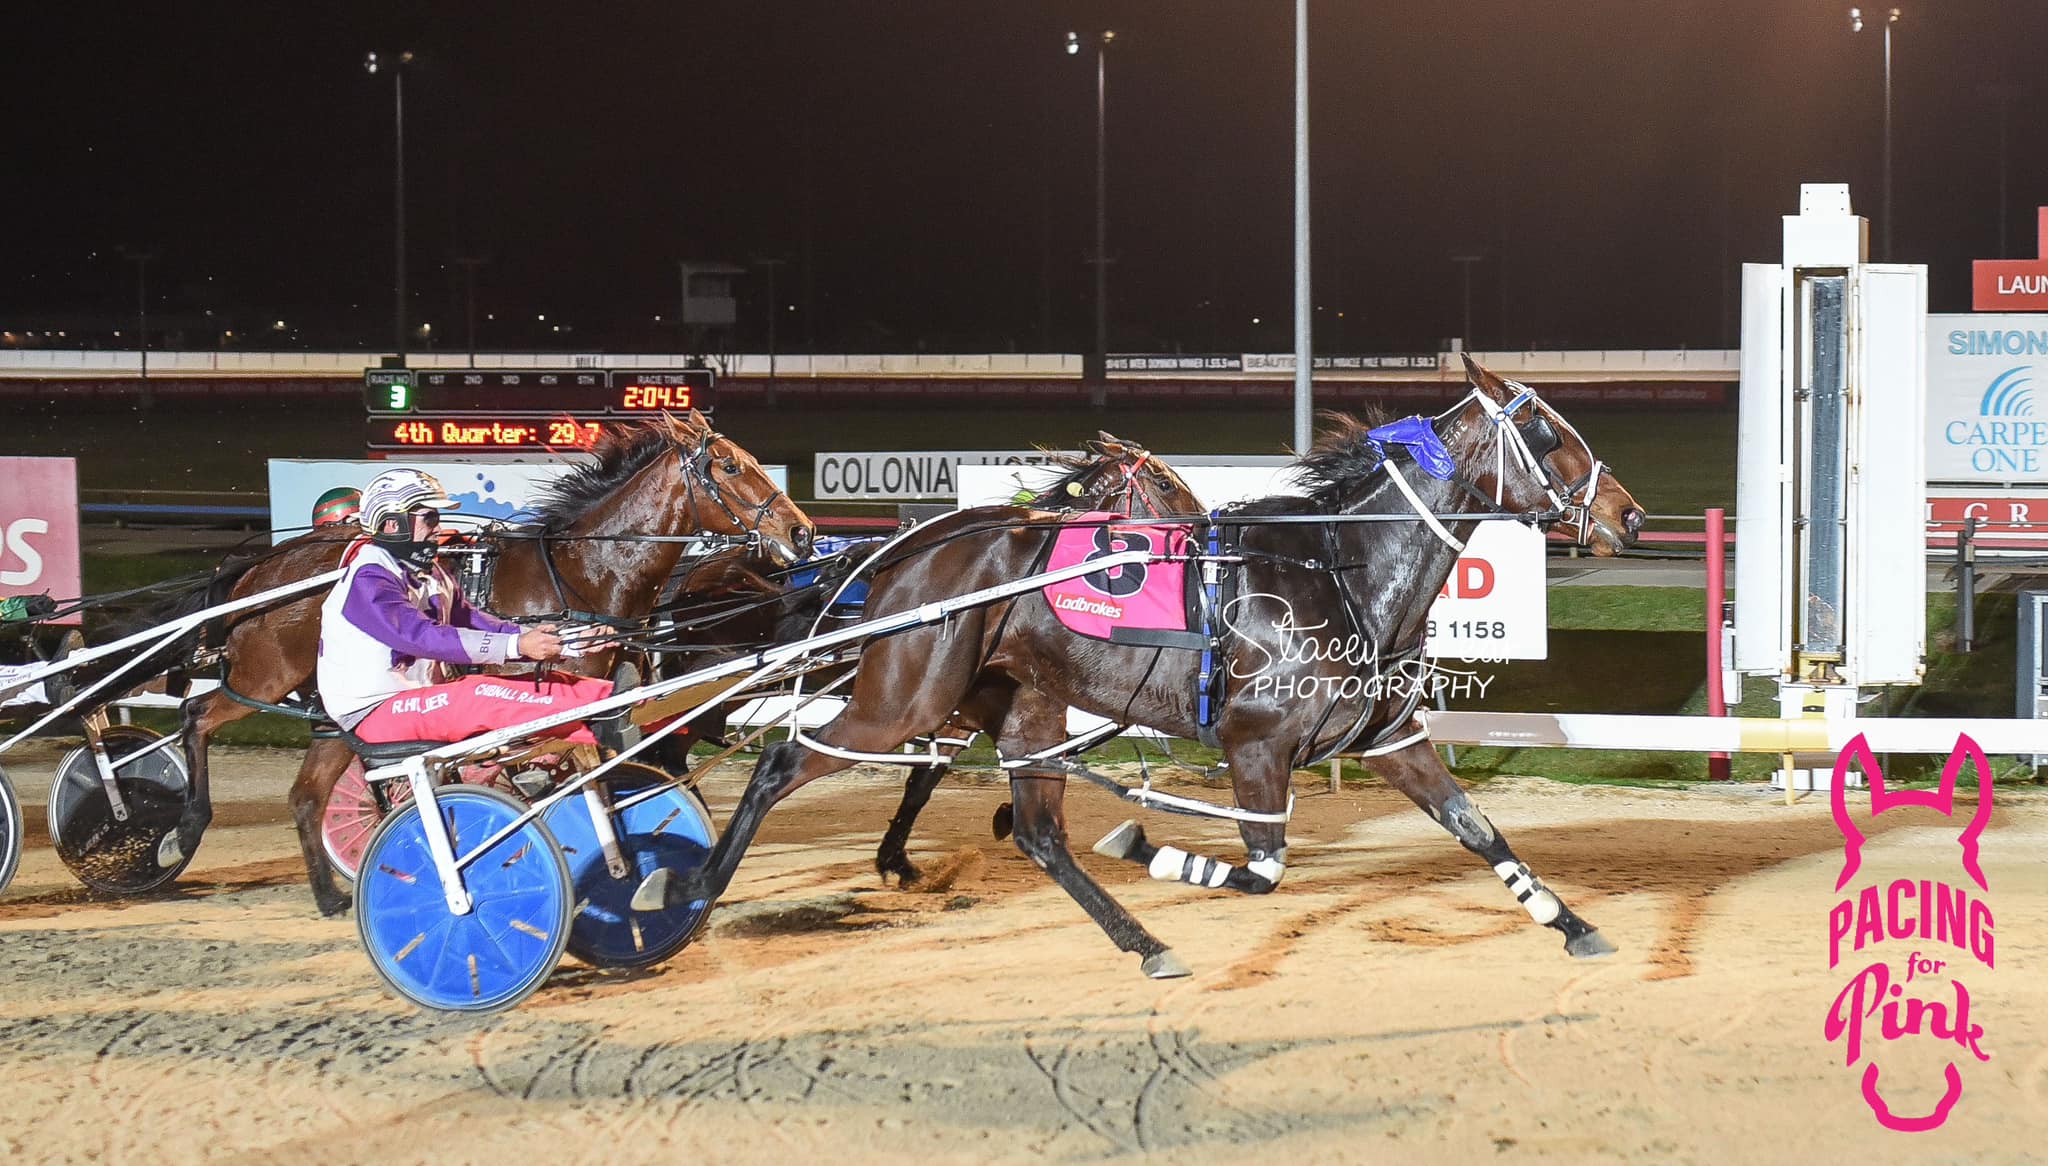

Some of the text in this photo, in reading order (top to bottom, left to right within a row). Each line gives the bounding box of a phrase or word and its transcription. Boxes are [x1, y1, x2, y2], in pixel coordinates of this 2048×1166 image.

[1948, 330, 2048, 355] SIMON
[371, 375, 394, 384] RACE
[429, 375, 595, 385] 1ST 2ND 3RD 4TH 5TH
[637, 375, 685, 385] RACE TIME
[390, 385, 406, 408] 3
[624, 386, 690, 407] 2:04.5
[394, 422, 600, 444] 4th Quarter: 29.7
[1945, 420, 2048, 446] CARPE
[1972, 447, 2041, 473] ONE
[1081, 524, 1153, 598] 8
[1437, 557, 1495, 599] D
[1055, 594, 1123, 619] Ladbrokes
[1449, 620, 1506, 639] 1158
